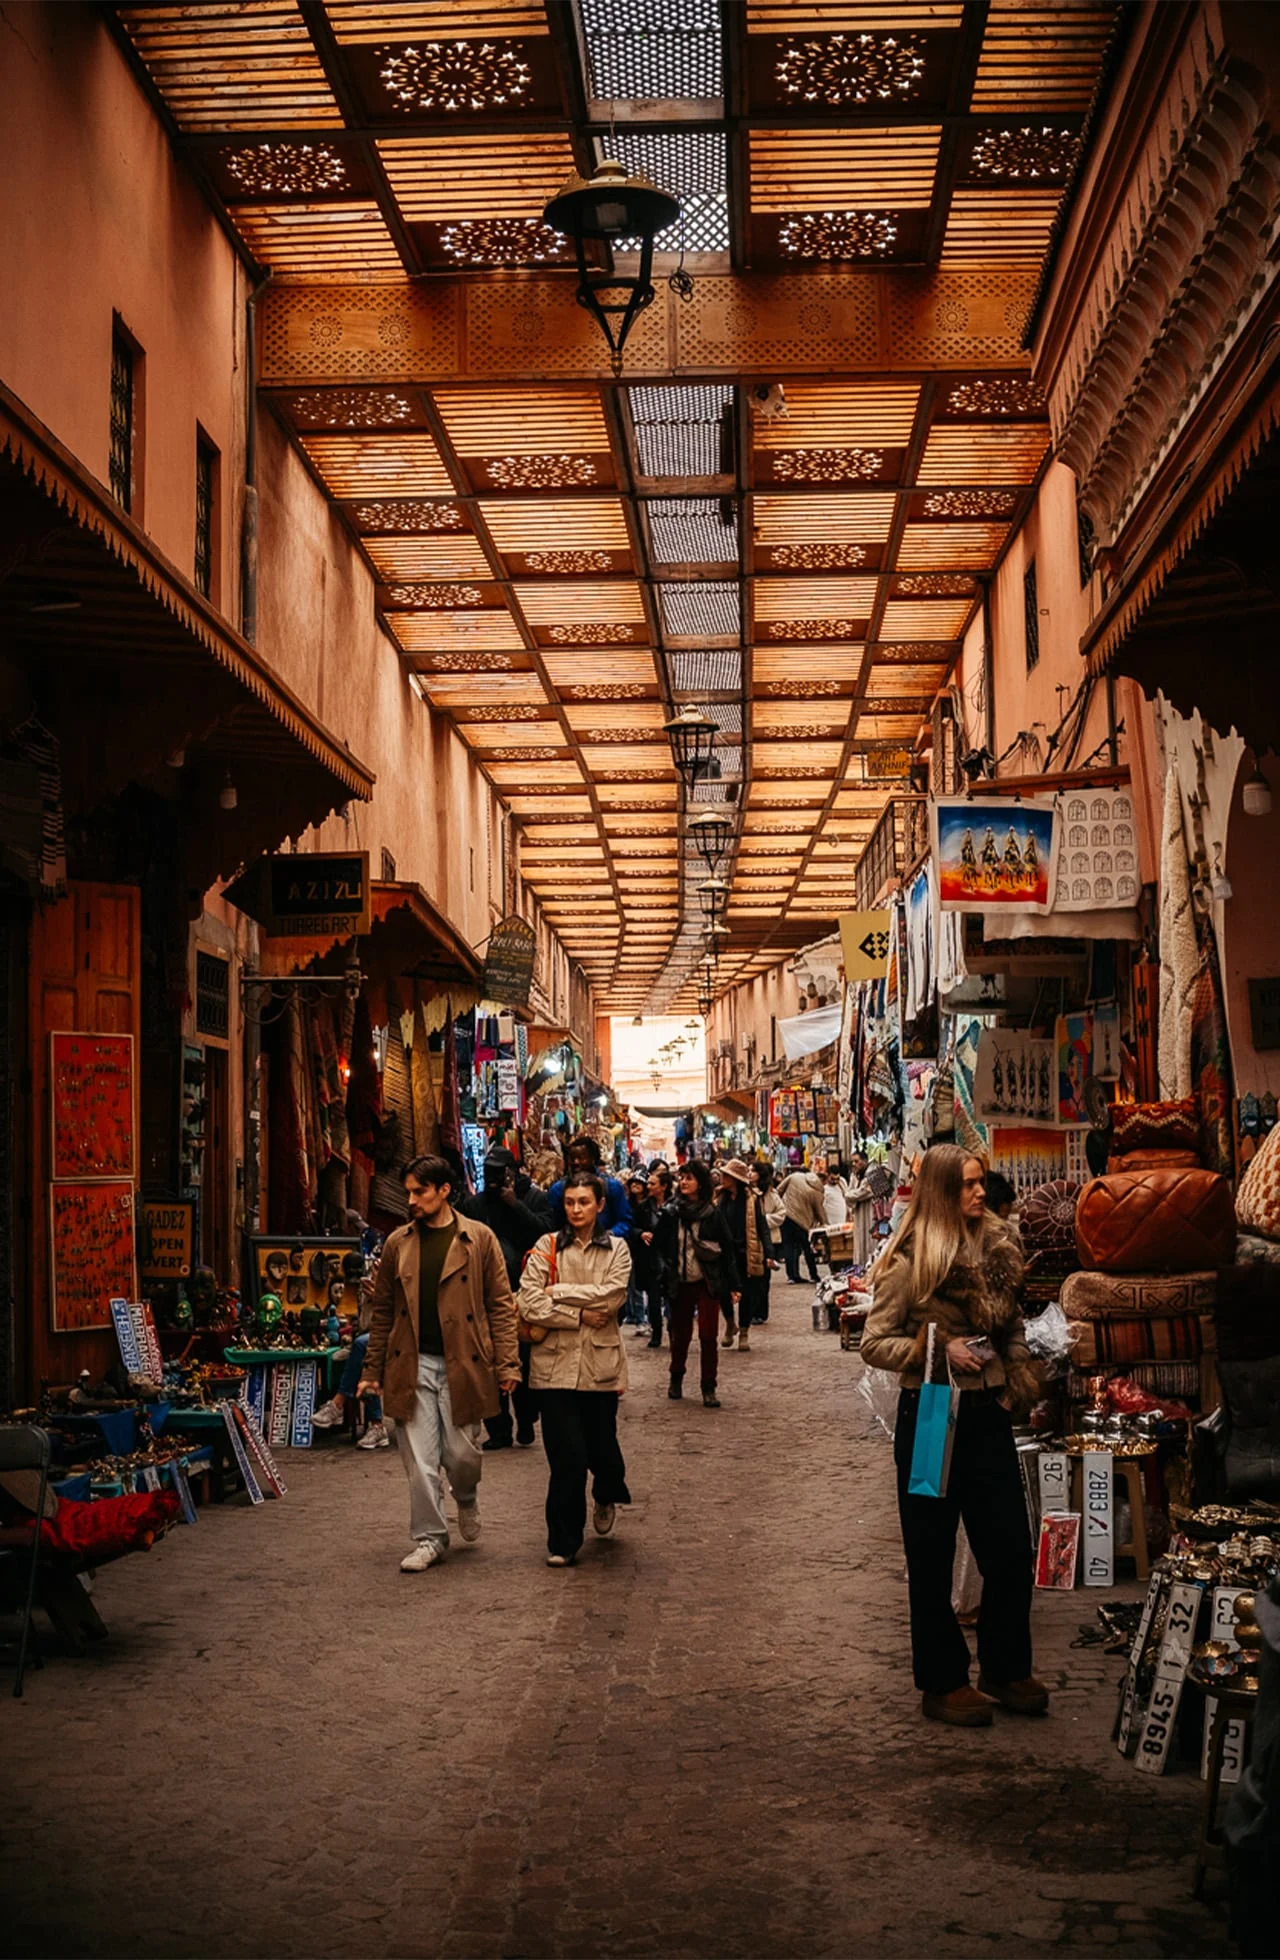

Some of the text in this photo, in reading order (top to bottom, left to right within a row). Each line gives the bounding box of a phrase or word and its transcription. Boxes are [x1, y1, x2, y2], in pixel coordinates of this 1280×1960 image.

[271, 1374, 291, 1443] MARRAKECH
[1043, 1462, 1063, 1482] 26
[1088, 1471, 1108, 1511] 2883
[1089, 1557, 1109, 1577] 40
[1143, 1692, 1174, 1755] 8945
[1169, 1602, 1194, 1633] 32
